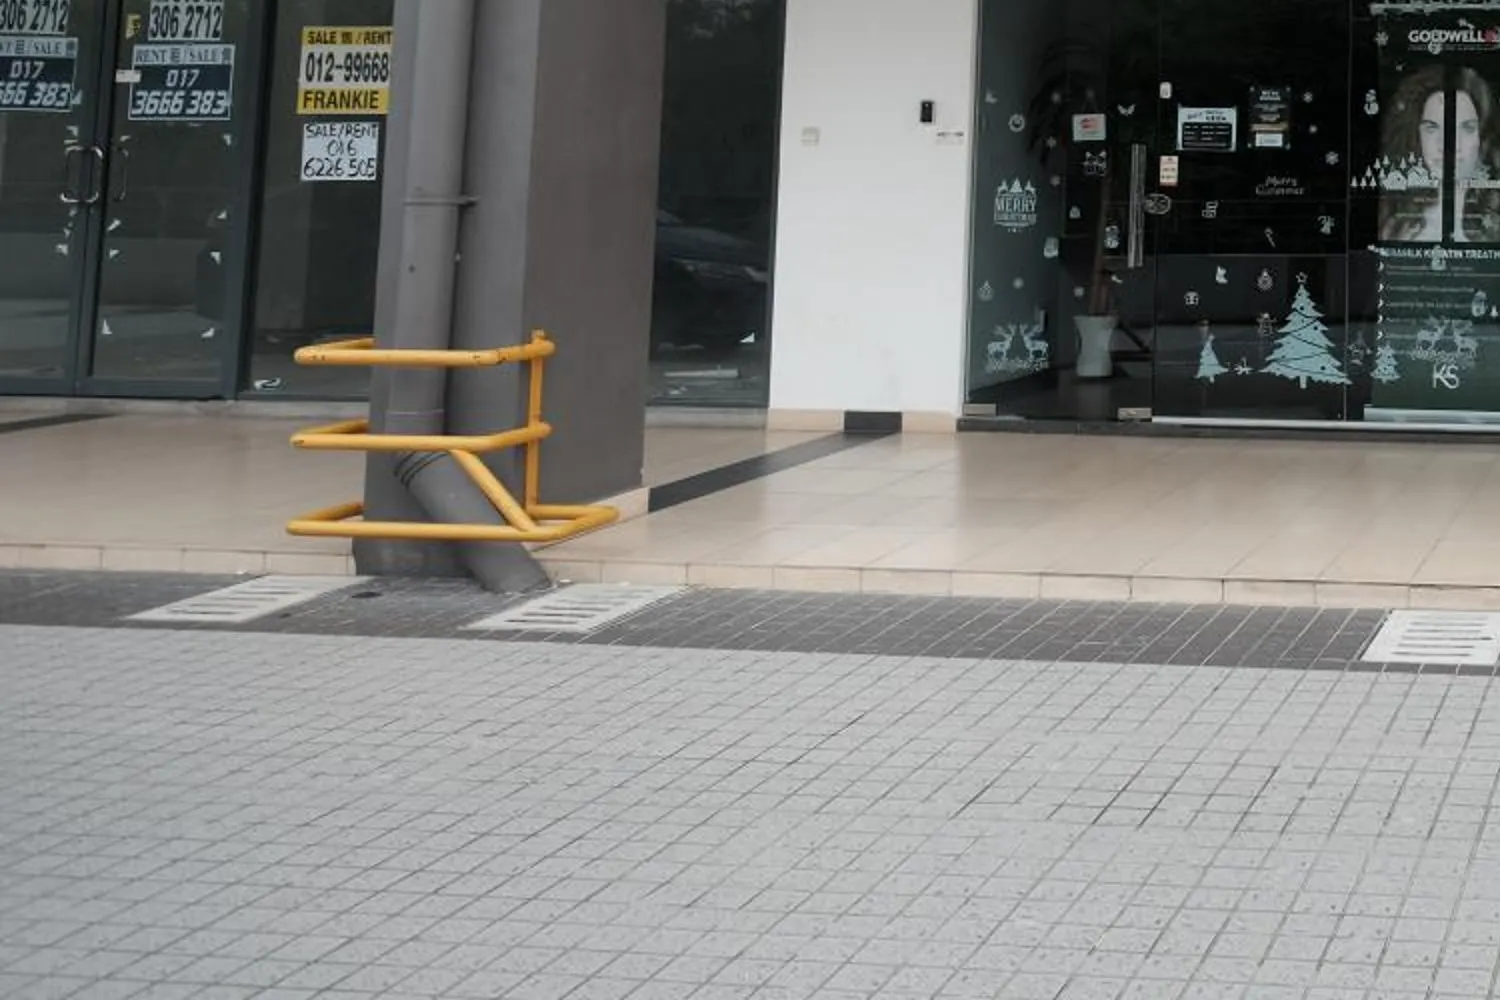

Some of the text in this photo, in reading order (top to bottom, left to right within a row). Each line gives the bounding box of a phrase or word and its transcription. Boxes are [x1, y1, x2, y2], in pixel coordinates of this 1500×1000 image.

[150, 5, 221, 38] 306 2712
[10, 61, 45, 79] 017
[165, 69, 200, 87] 017
[29, 83, 72, 107] 383
[131, 89, 229, 115] 3666 383
[303, 91, 379, 110] FRANKIE
